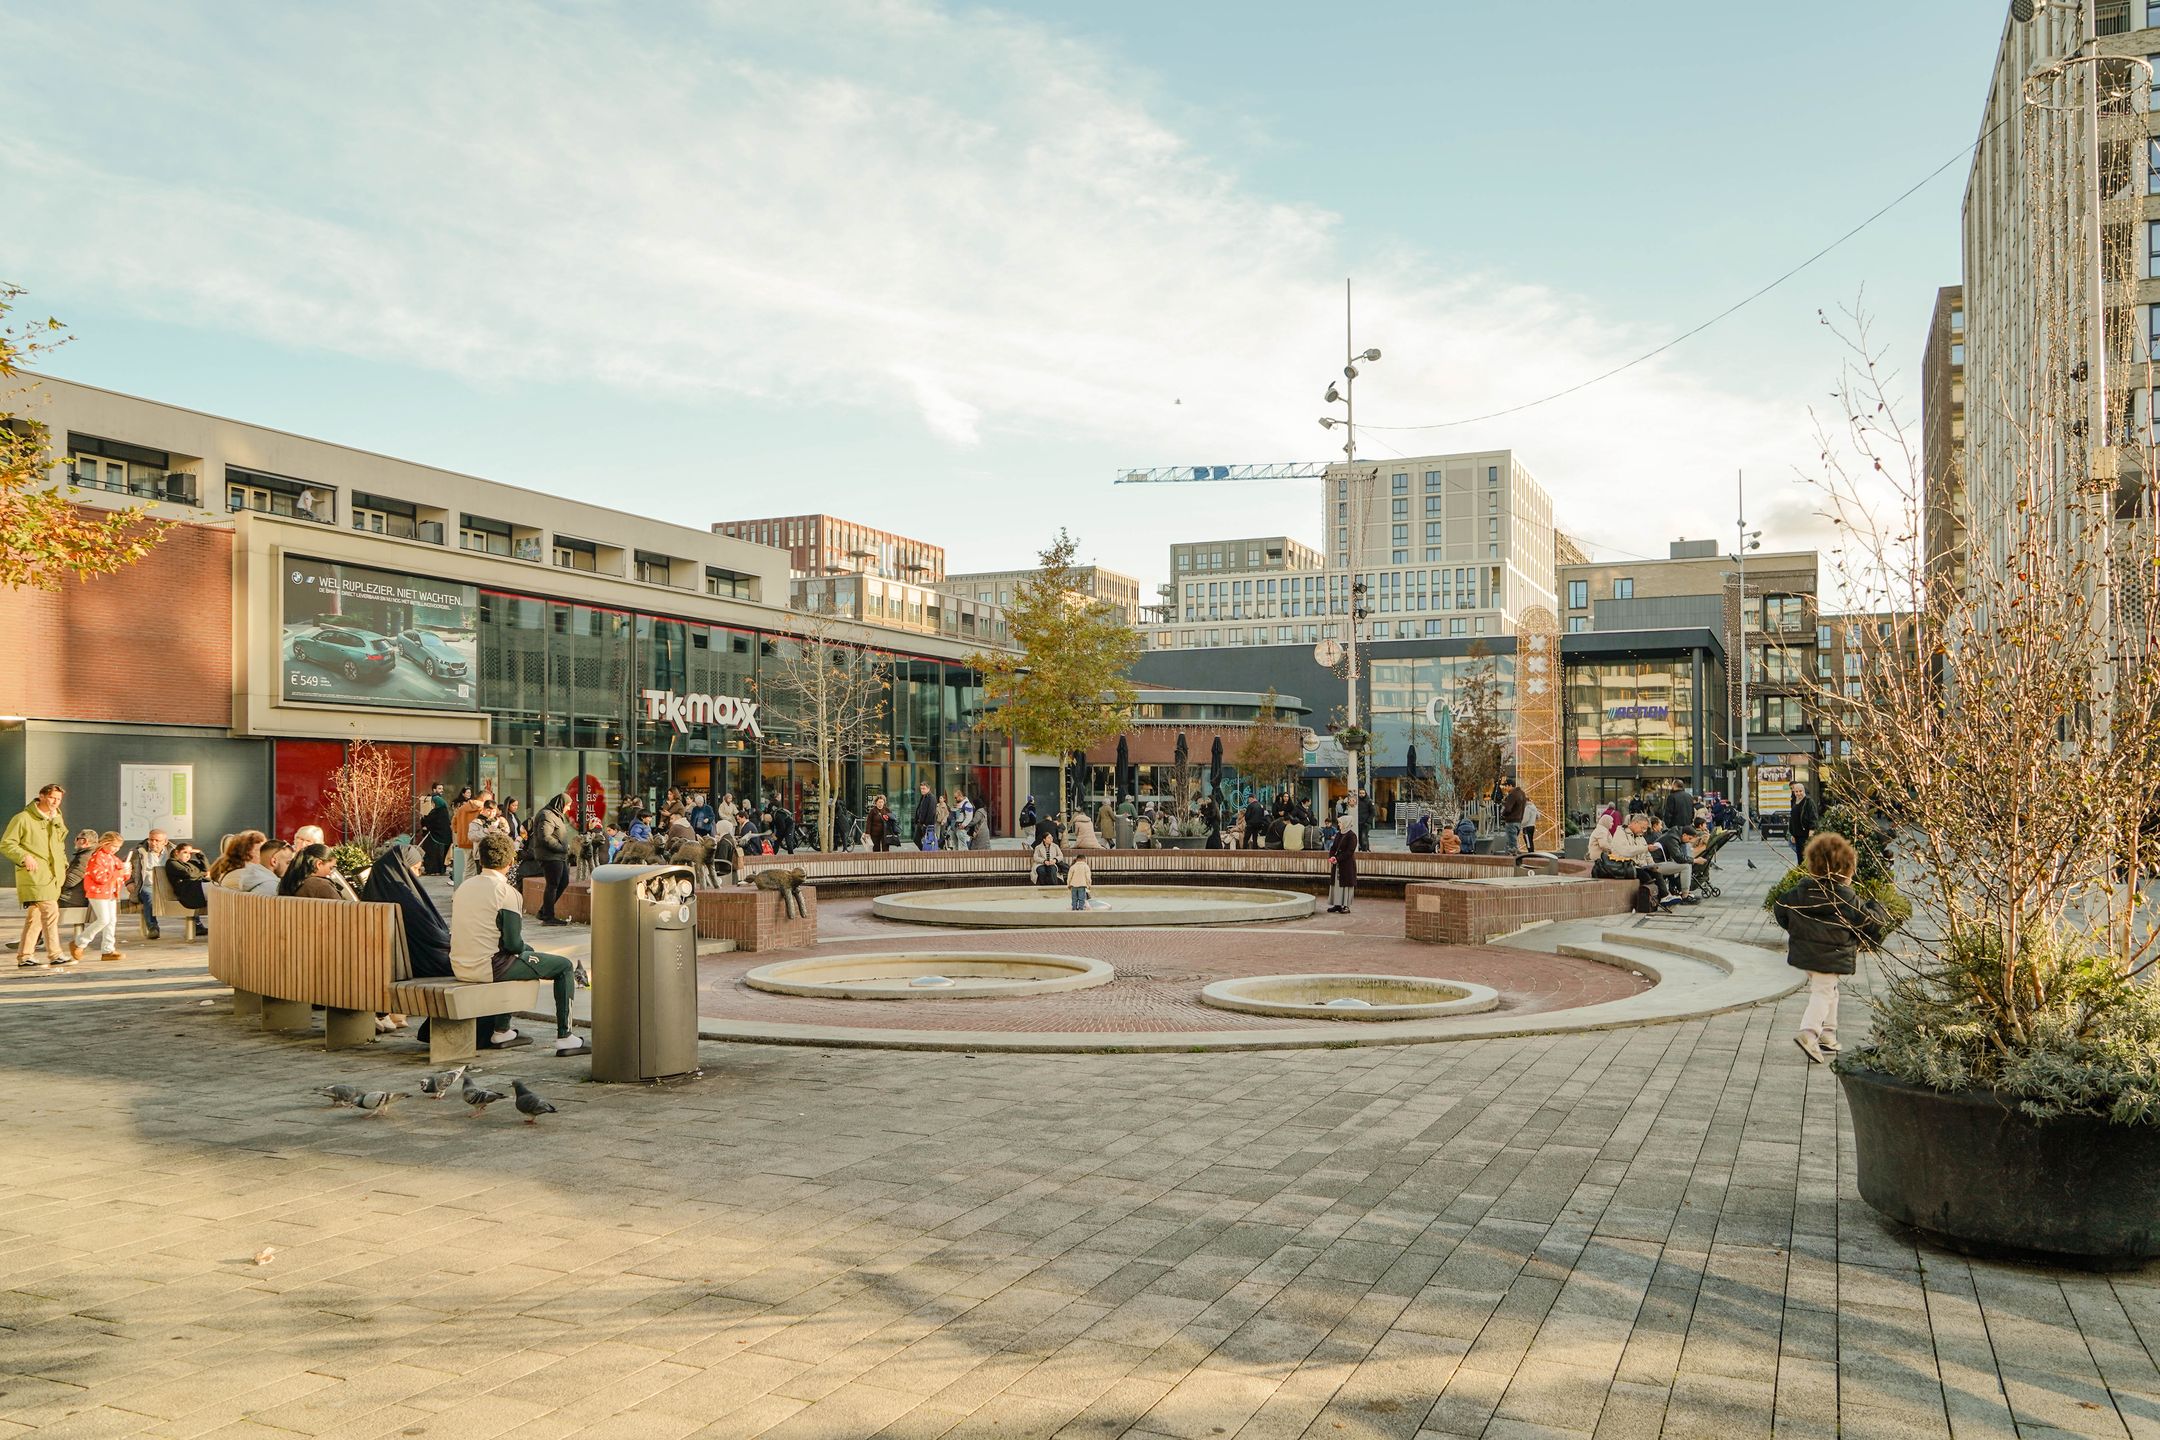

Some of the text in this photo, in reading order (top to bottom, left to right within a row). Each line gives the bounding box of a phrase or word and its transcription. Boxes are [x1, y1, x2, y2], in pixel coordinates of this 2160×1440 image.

[318, 576, 464, 606] WEL RIJPLEZIER. NIET WACHTEN.
[291, 674, 298, 686] €
[300, 675, 319, 687] 549
[1614, 705, 1669, 719] ACTION
